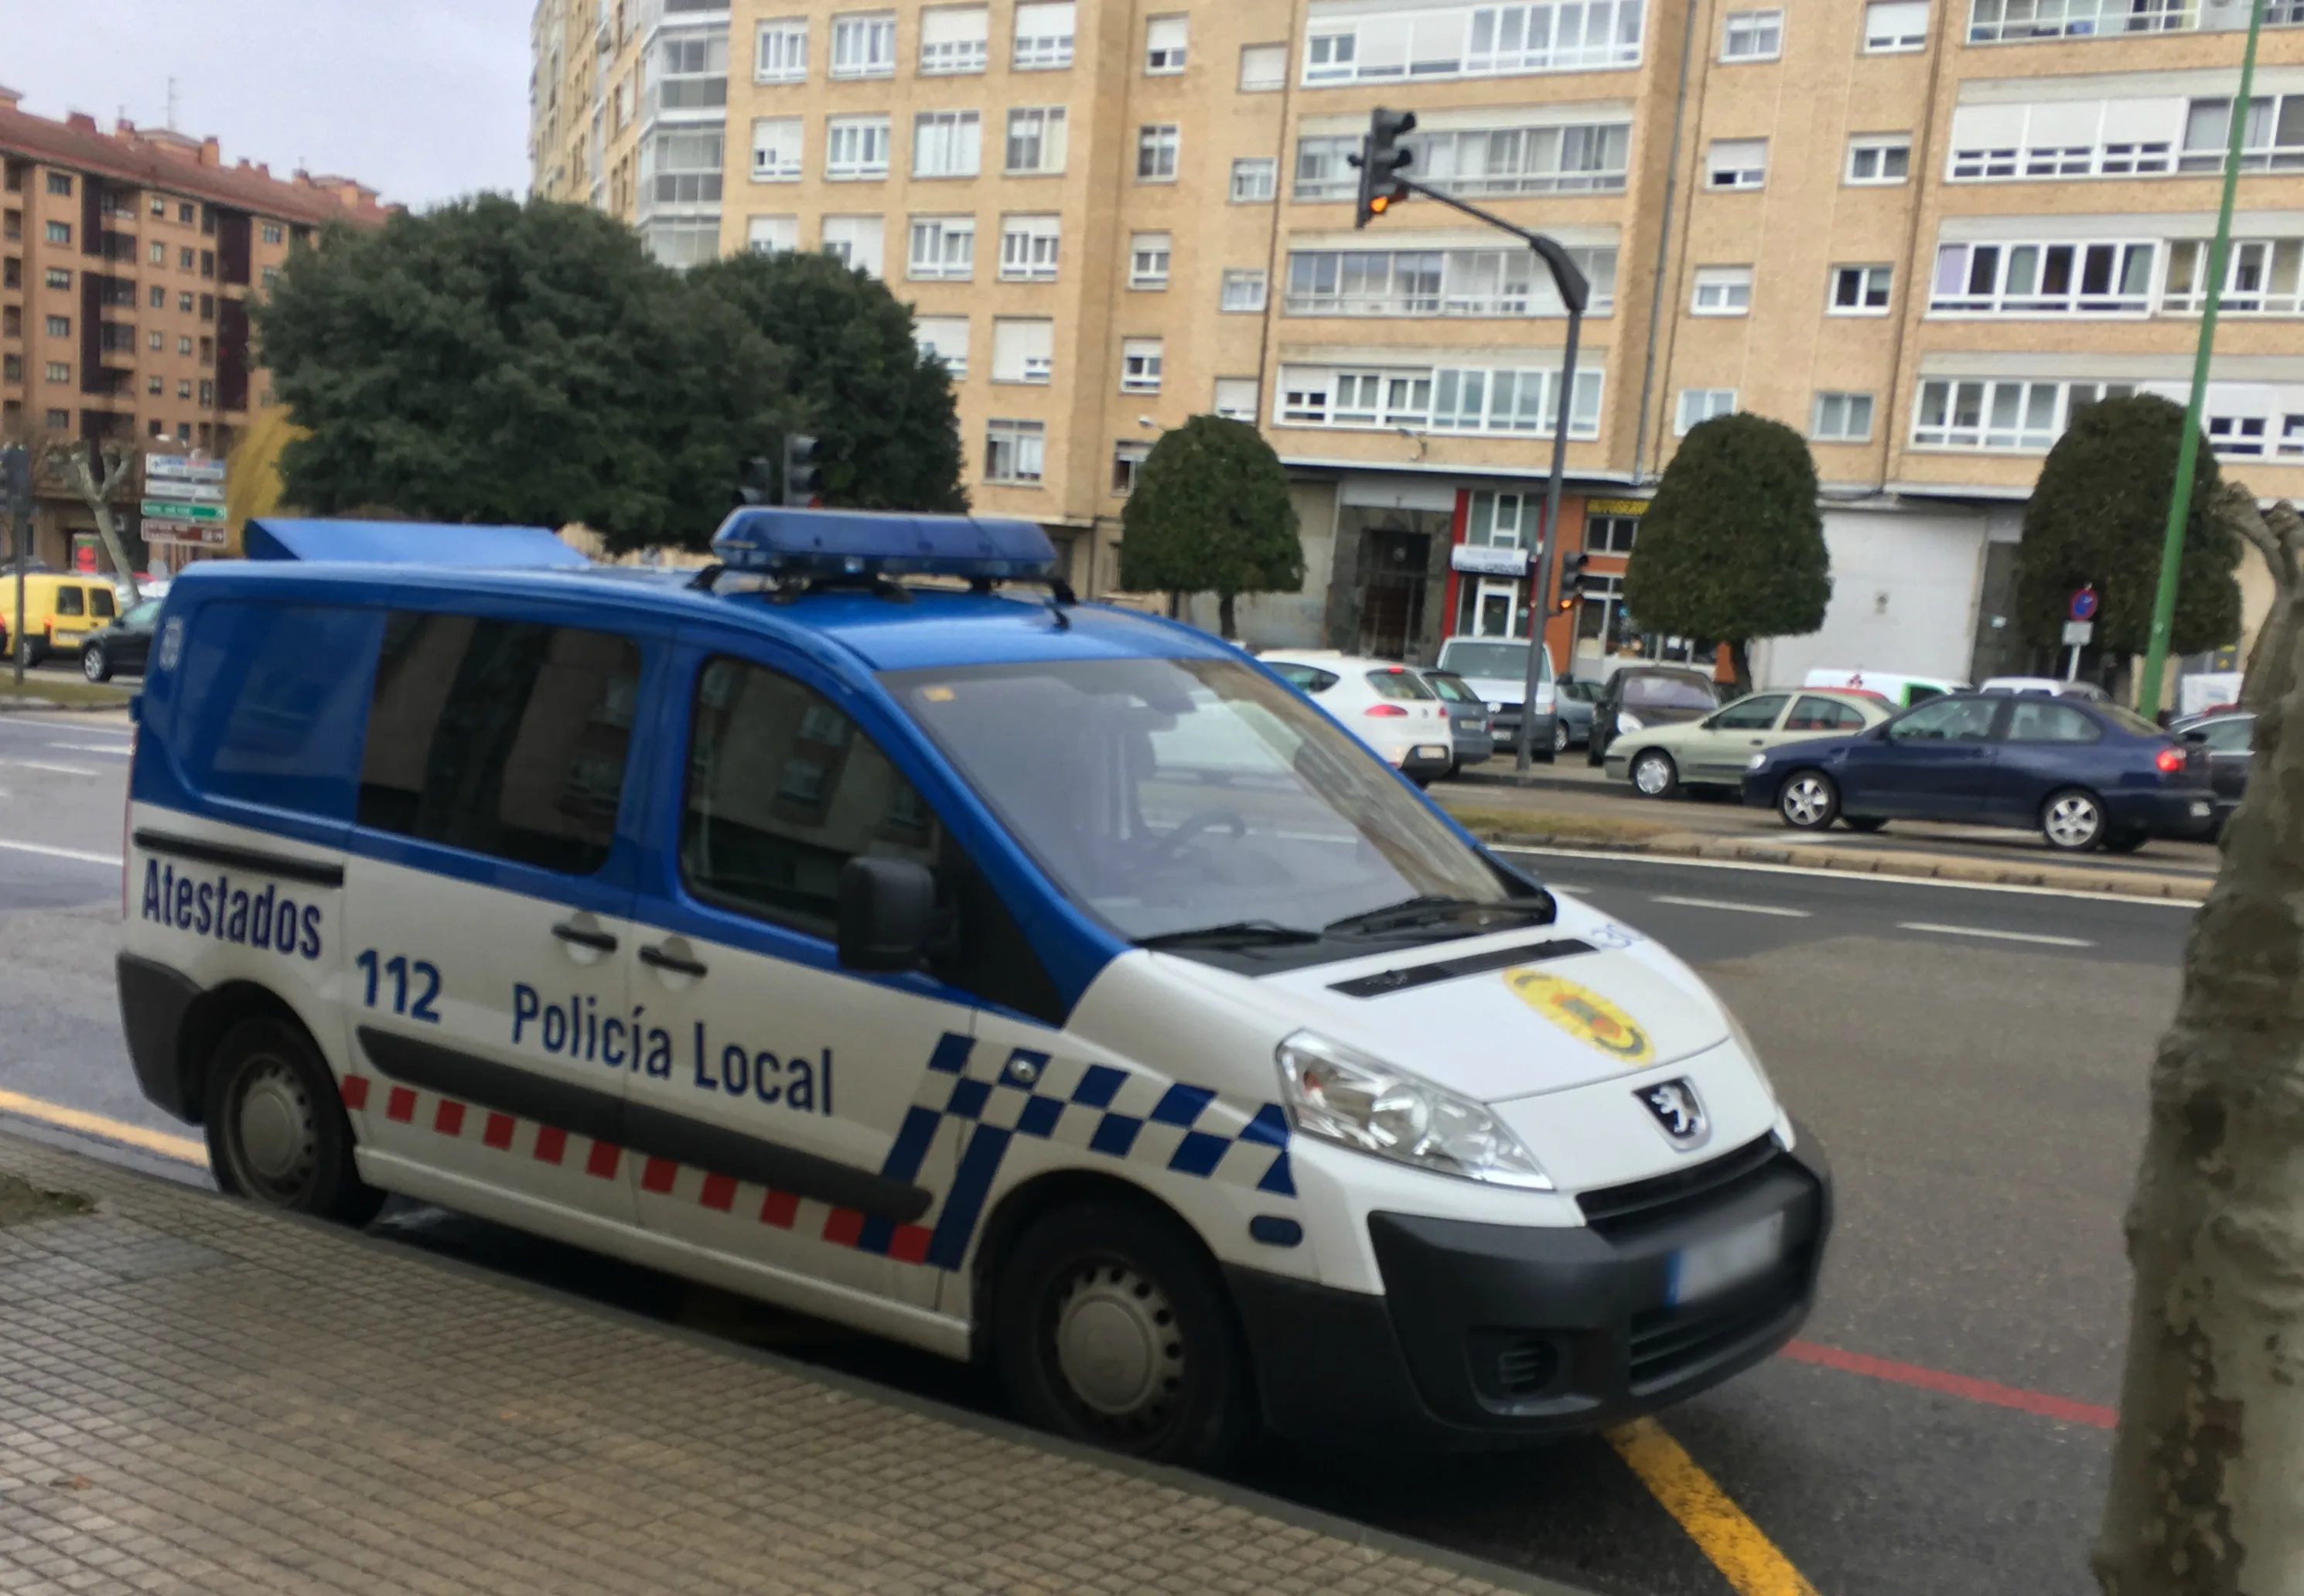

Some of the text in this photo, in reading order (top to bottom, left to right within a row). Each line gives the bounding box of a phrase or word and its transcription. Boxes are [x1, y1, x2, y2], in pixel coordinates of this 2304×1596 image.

[142, 858, 322, 960] Atestados
[355, 949, 442, 1024] 112
[511, 981, 833, 1117] Policía Local
